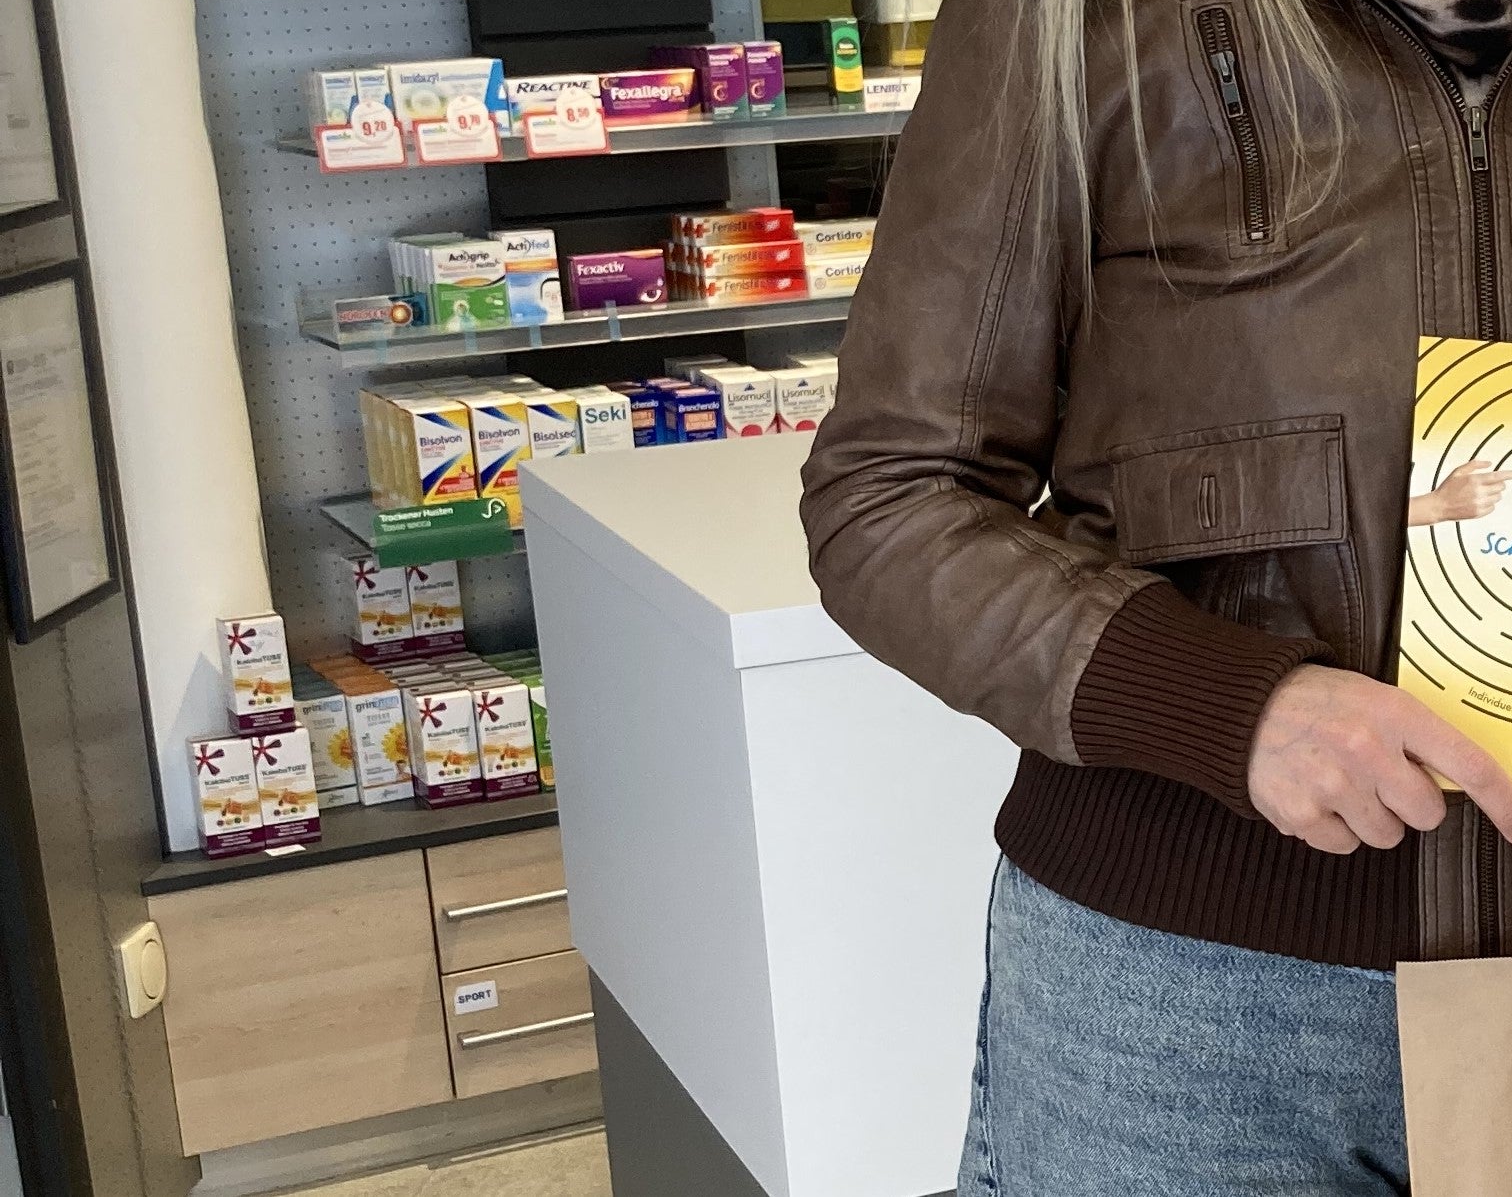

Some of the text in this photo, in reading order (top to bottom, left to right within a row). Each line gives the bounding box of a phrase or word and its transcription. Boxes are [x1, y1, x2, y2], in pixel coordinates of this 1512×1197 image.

[516, 81, 592, 94] REACTINE
[610, 84, 682, 101] Fexallegra
[816, 231, 863, 243] Cortidro
[577, 262, 625, 276] Fexactiv
[825, 266, 865, 278] Cortid
[728, 392, 771, 404] Lisomucil
[781, 386, 826, 400] Lisomucil
[632, 400, 659, 409] chenolo
[584, 404, 627, 424] Seki
[419, 434, 463, 448] Bisolvon
[478, 428, 520, 441] Bisolvon
[423, 507, 453, 517] Husten
[457, 988, 493, 1006] SPORT
